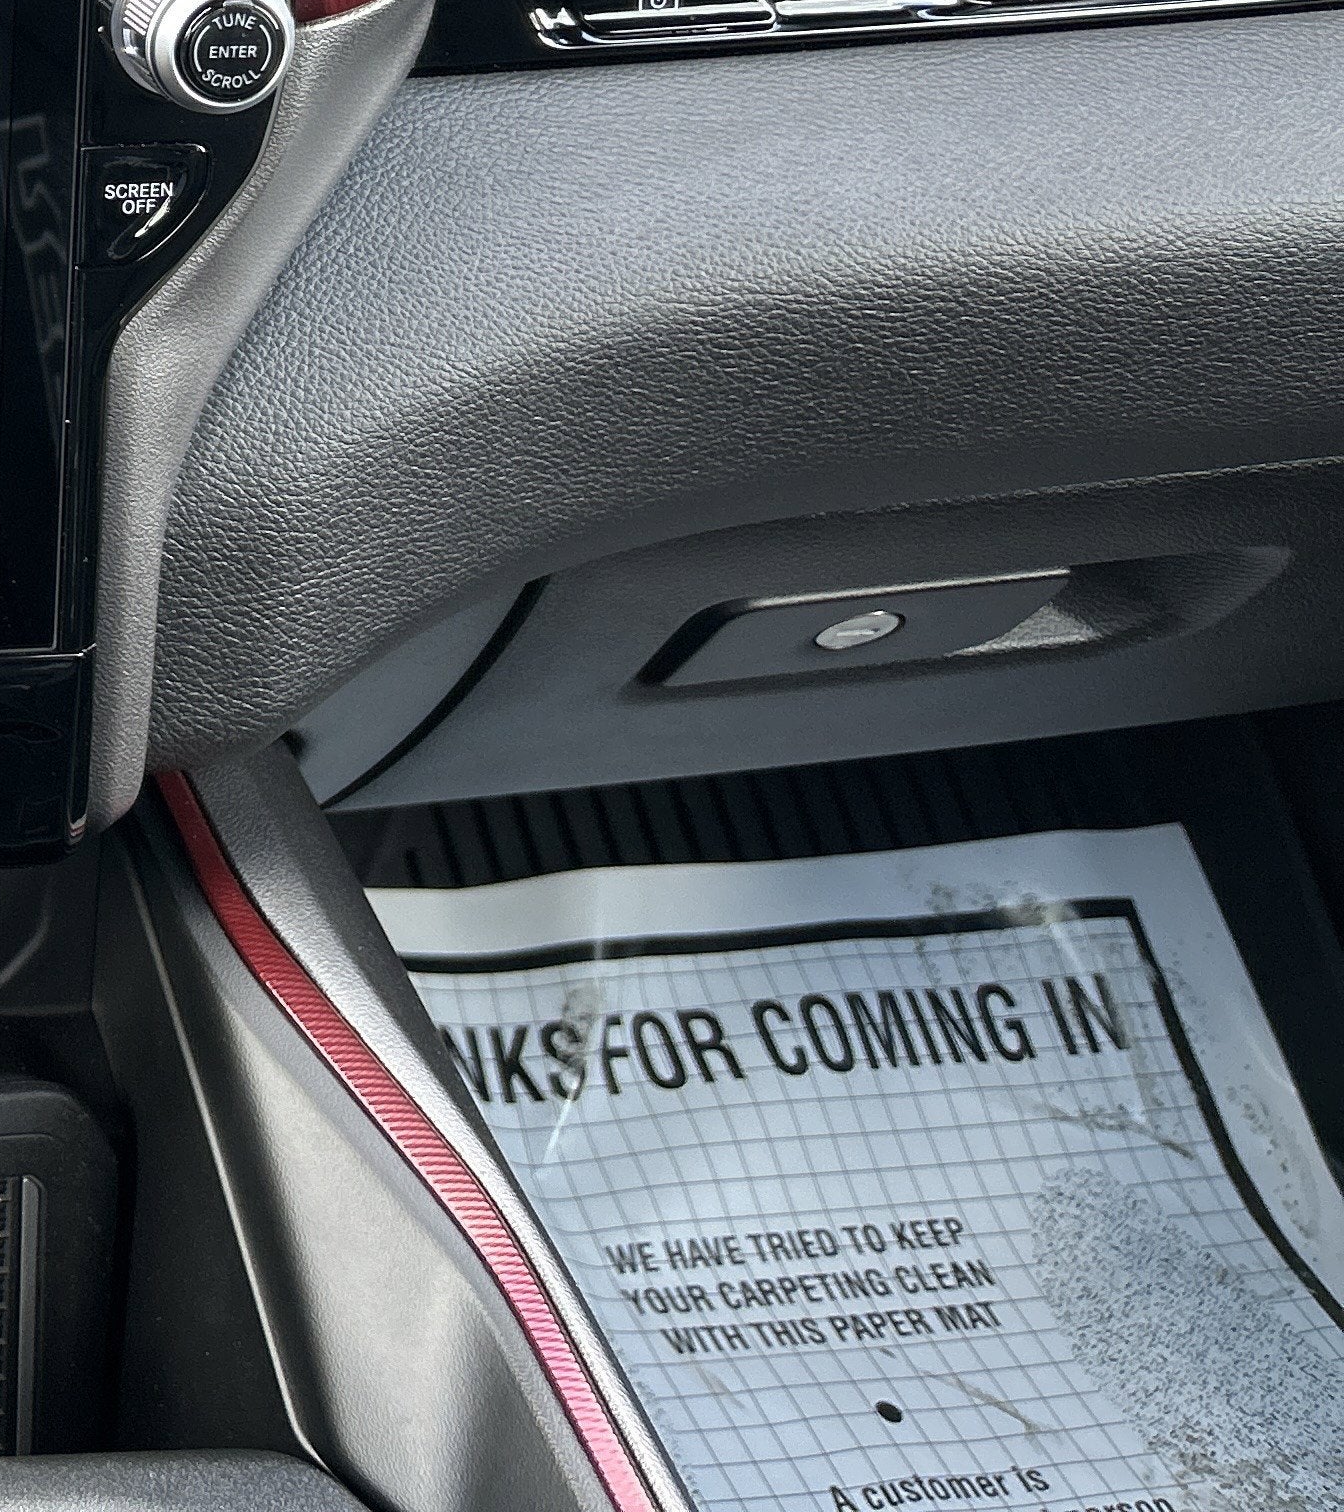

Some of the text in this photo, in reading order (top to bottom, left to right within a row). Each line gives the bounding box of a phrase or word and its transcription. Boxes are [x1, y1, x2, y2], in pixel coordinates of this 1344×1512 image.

[211, 12, 258, 31] TUNE
[206, 42, 260, 61] ENTER
[201, 67, 262, 89] SCROLL
[103, 182, 174, 200] SCREEN
[121, 198, 157, 215] OFF
[439, 972, 1132, 1103] NKS FOR COMING IN
[606, 1216, 965, 1274] WE HAVE TRIED TO KEEP
[618, 1259, 995, 1316] YOUR CARPETING CLEAN
[660, 1299, 1005, 1356] WITH THIS PAPER MAT
[828, 1485, 858, 1512] A
[860, 1476, 1008, 1512] customer
[1014, 1465, 1050, 1493] is
